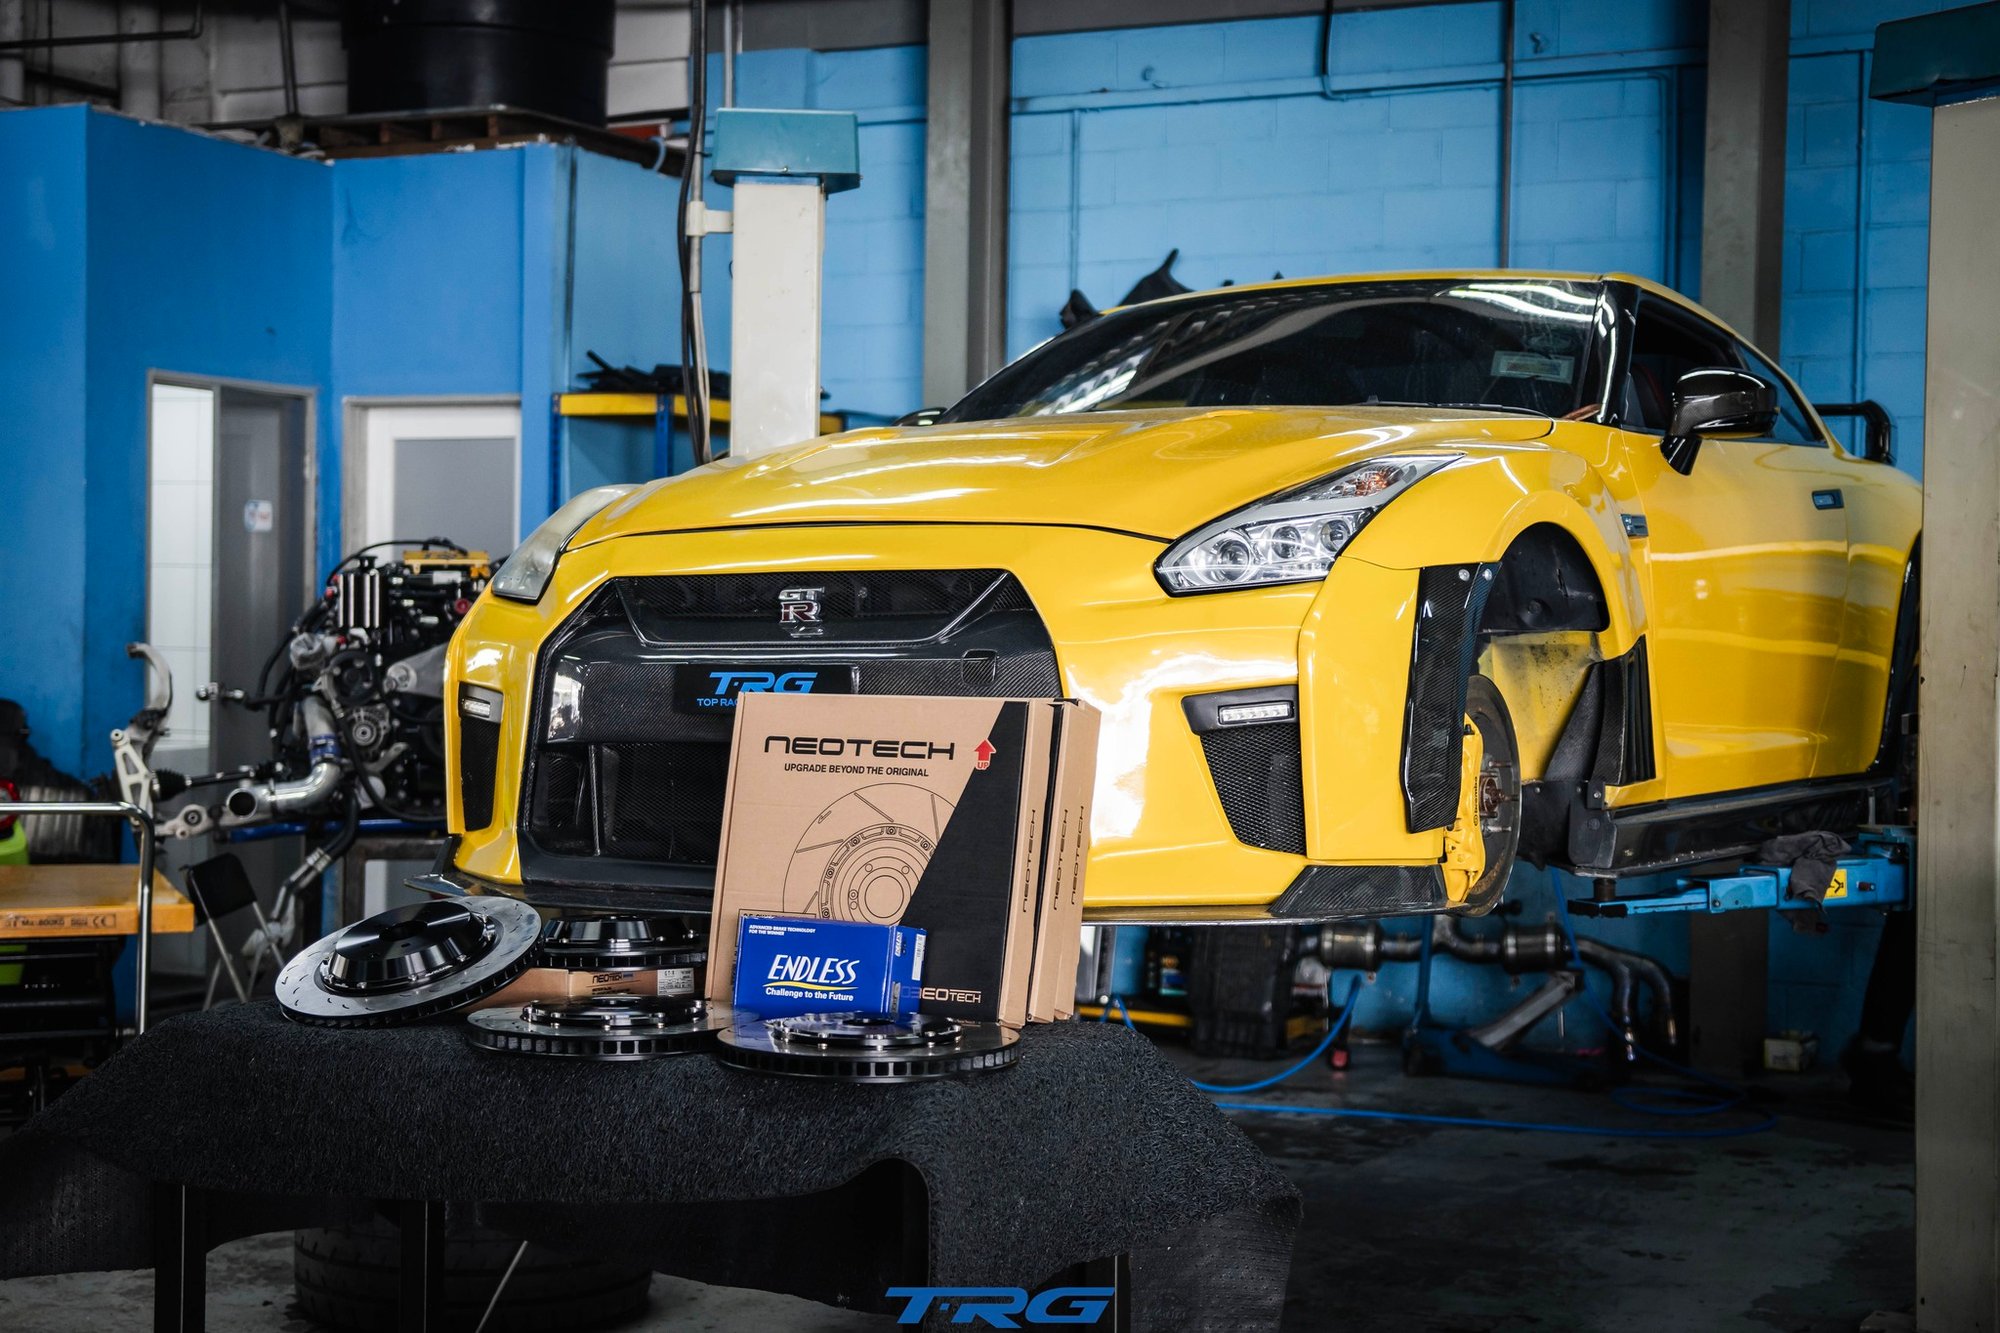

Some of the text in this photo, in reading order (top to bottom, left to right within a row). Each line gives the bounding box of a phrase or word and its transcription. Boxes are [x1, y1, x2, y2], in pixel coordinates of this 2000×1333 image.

[697, 698, 719, 707] TOP
[764, 735, 955, 760] NEOTECH
[784, 763, 929, 777] UPGRADE BEYOND THE ORIGINAL
[976, 761, 989, 770] UP
[1023, 809, 1036, 912] NEOTECH
[1054, 809, 1068, 910] NEOTECH
[1071, 805, 1084, 905] NEOTECH
[767, 954, 860, 984] ENDLESS
[765, 987, 803, 999] Challenge
[814, 991, 827, 999] the
[828, 992, 854, 1001] Future
[919, 987, 981, 1003] EOTECH
